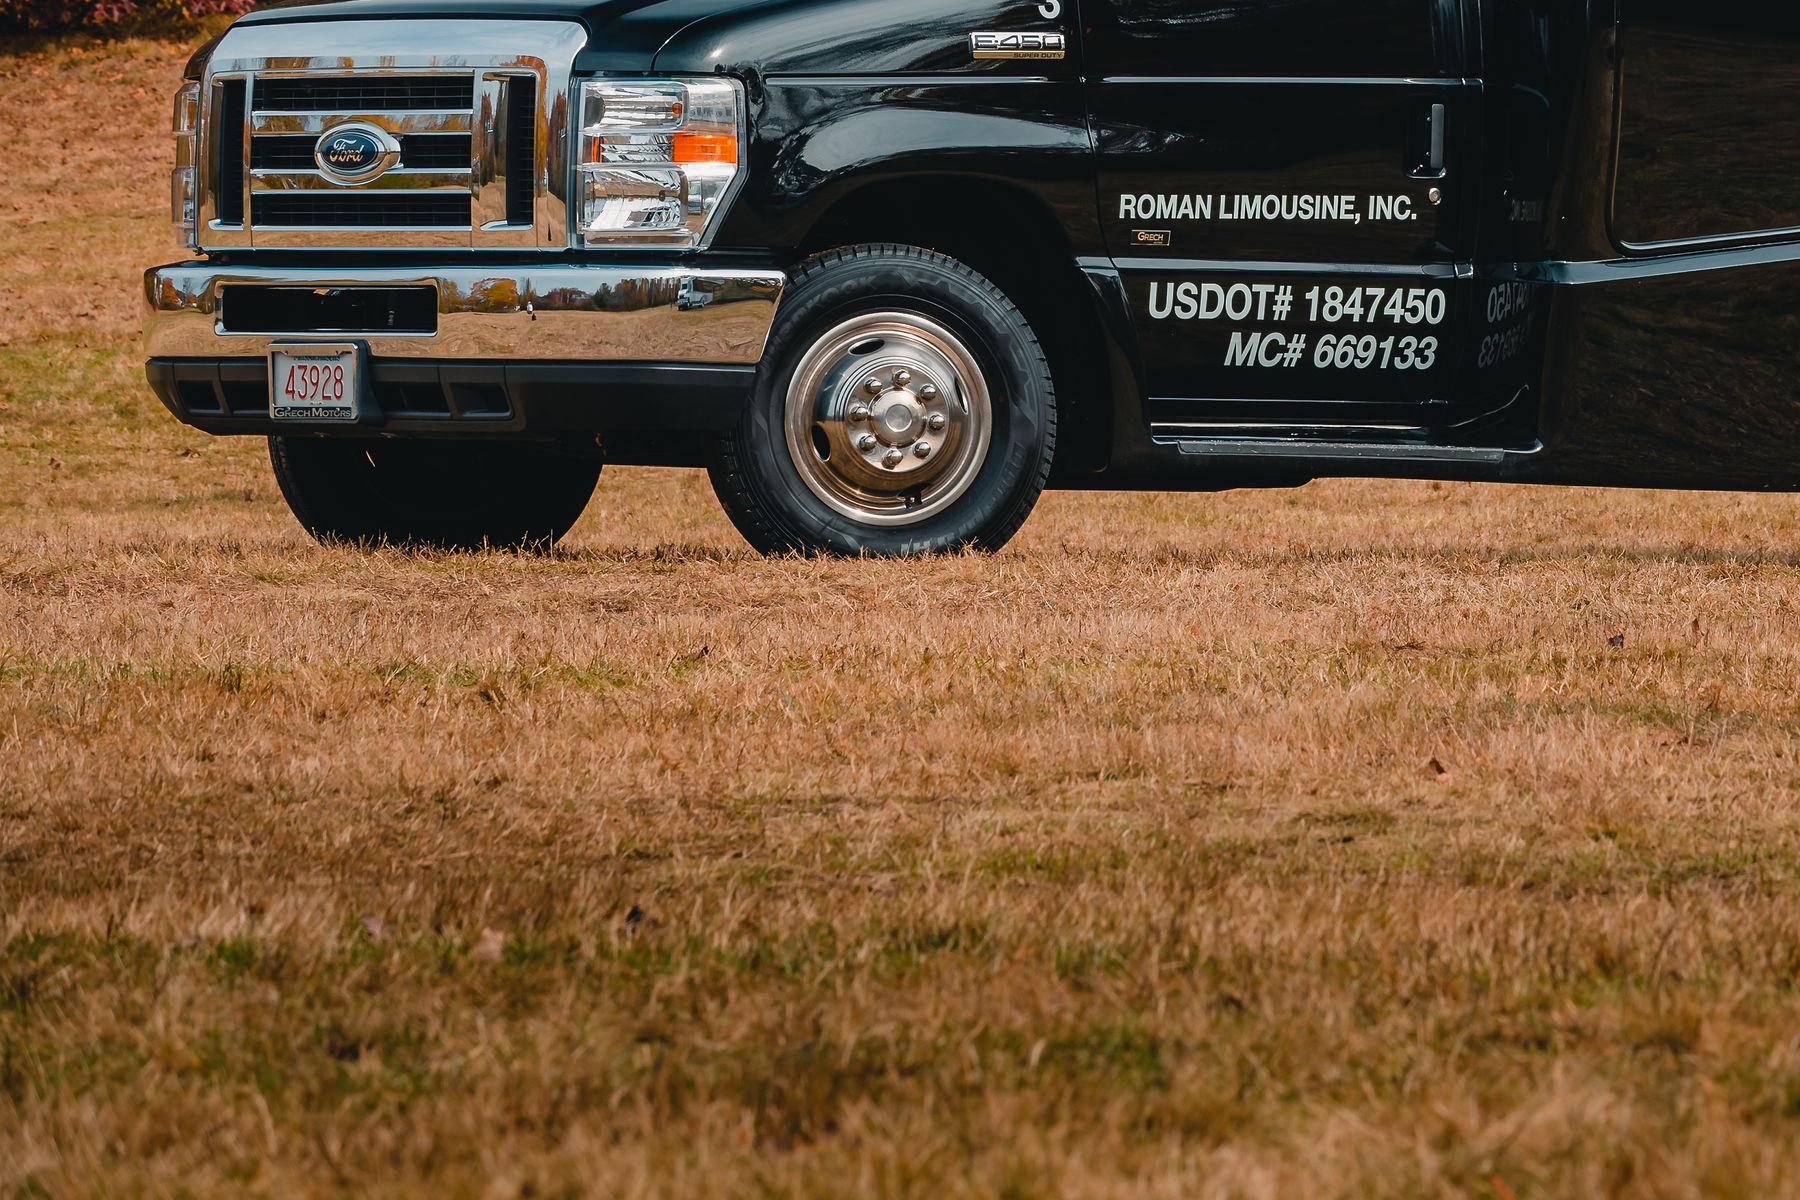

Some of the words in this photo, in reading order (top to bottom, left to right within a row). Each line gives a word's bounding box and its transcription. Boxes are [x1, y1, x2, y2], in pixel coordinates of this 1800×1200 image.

[1013, 51, 1039, 59] SUPER
[1041, 51, 1062, 59] DUTY
[329, 138, 365, 162] Ford
[1118, 194, 1213, 220] ROMAN
[1218, 194, 1361, 225] LIMOUSINE,
[1368, 195, 1417, 220] INC.
[1148, 281, 1294, 321] USDOT#
[1305, 286, 1446, 325] 1847450
[1223, 332, 1305, 368] MC#
[1313, 333, 1438, 370] 669133
[285, 365, 343, 400] 43928
[274, 407, 311, 417] GRECH
